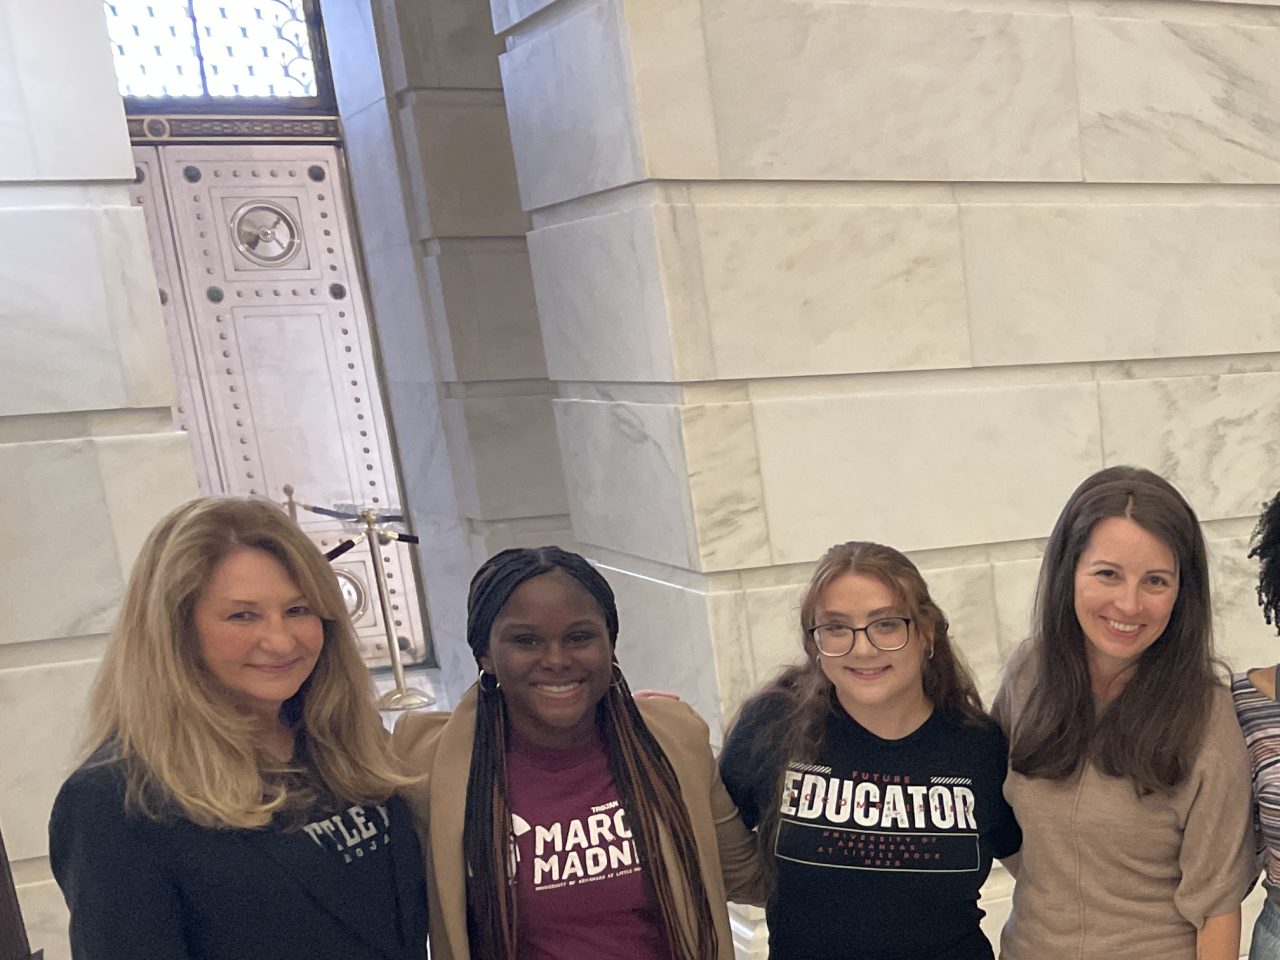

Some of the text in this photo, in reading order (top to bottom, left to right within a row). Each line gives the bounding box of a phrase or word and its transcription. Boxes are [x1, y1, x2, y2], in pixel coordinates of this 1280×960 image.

[851, 770, 911, 785] FUTURE
[591, 800, 619, 813] TROJAN
[779, 770, 978, 830] EDUCATOR
[533, 840, 640, 885] MADN
